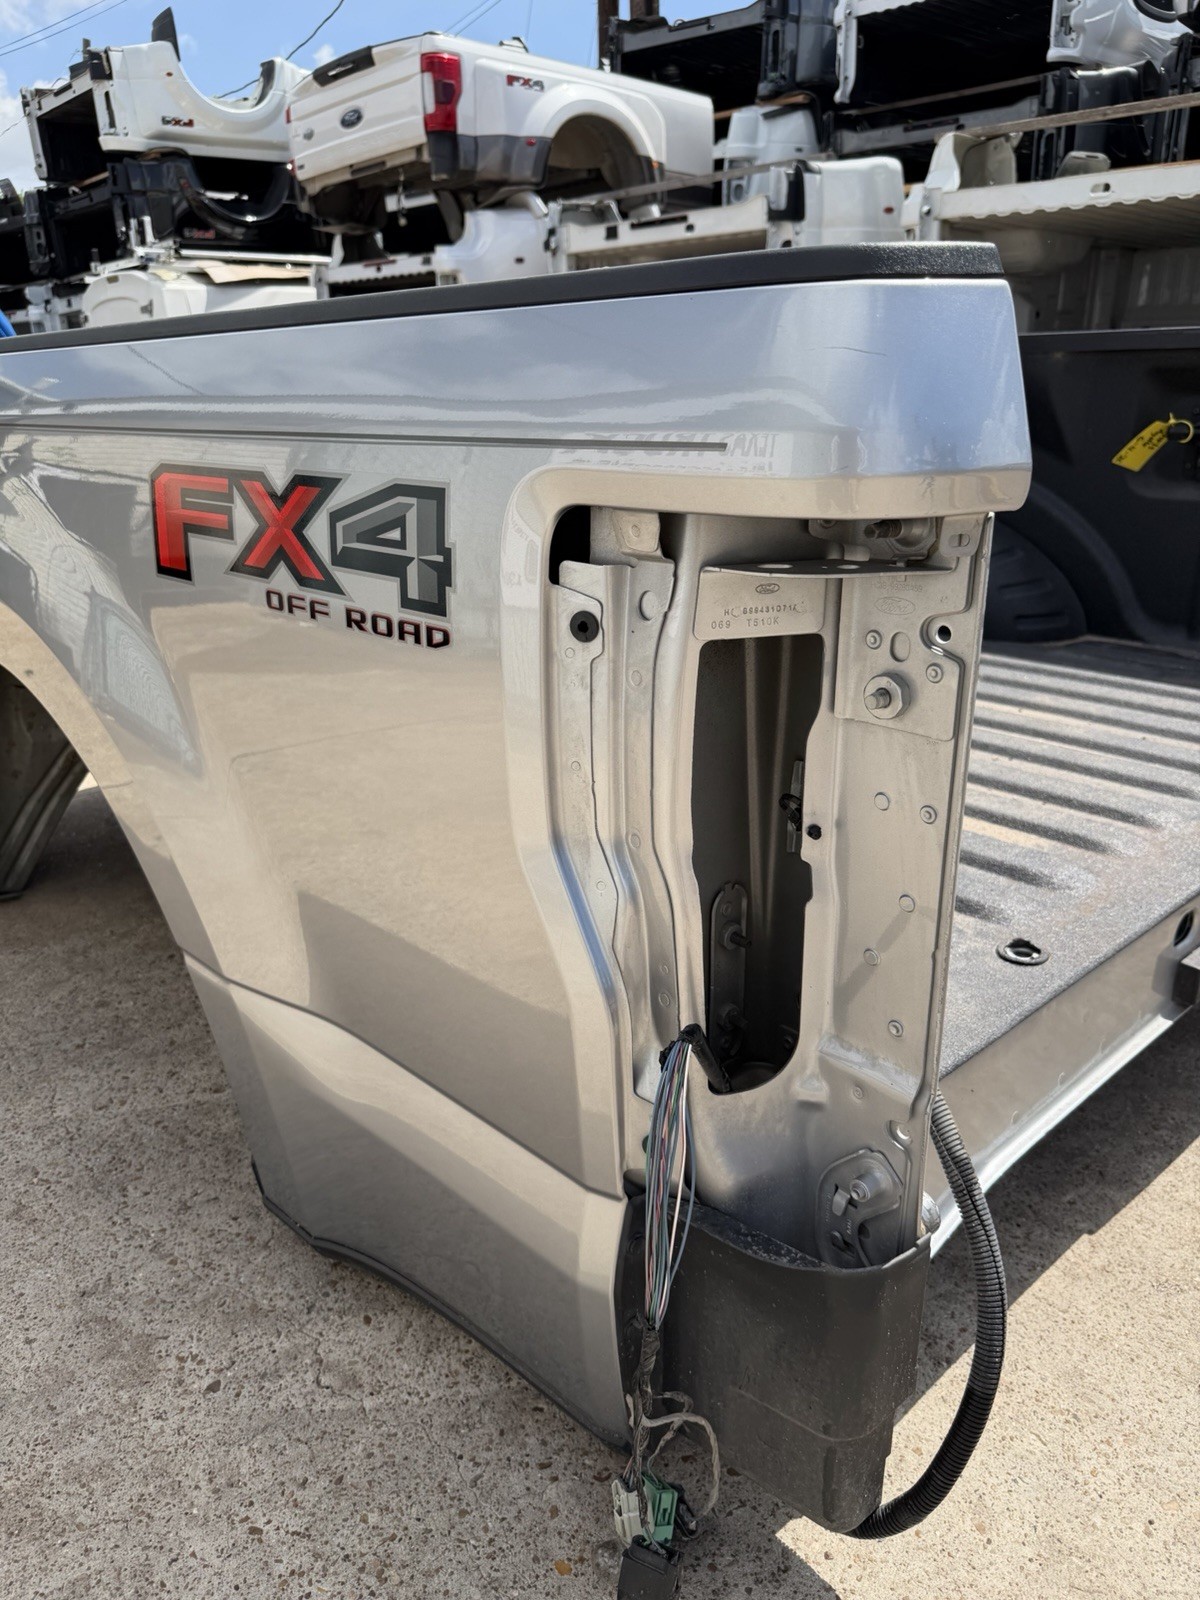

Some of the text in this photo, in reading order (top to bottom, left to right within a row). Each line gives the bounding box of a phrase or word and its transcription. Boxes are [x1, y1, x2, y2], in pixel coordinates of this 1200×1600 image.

[506, 74, 545, 92] FX4
[150, 460, 454, 618] FX4
[265, 588, 452, 649] OFF ROAD
[711, 616, 780, 630] 069 T510K
